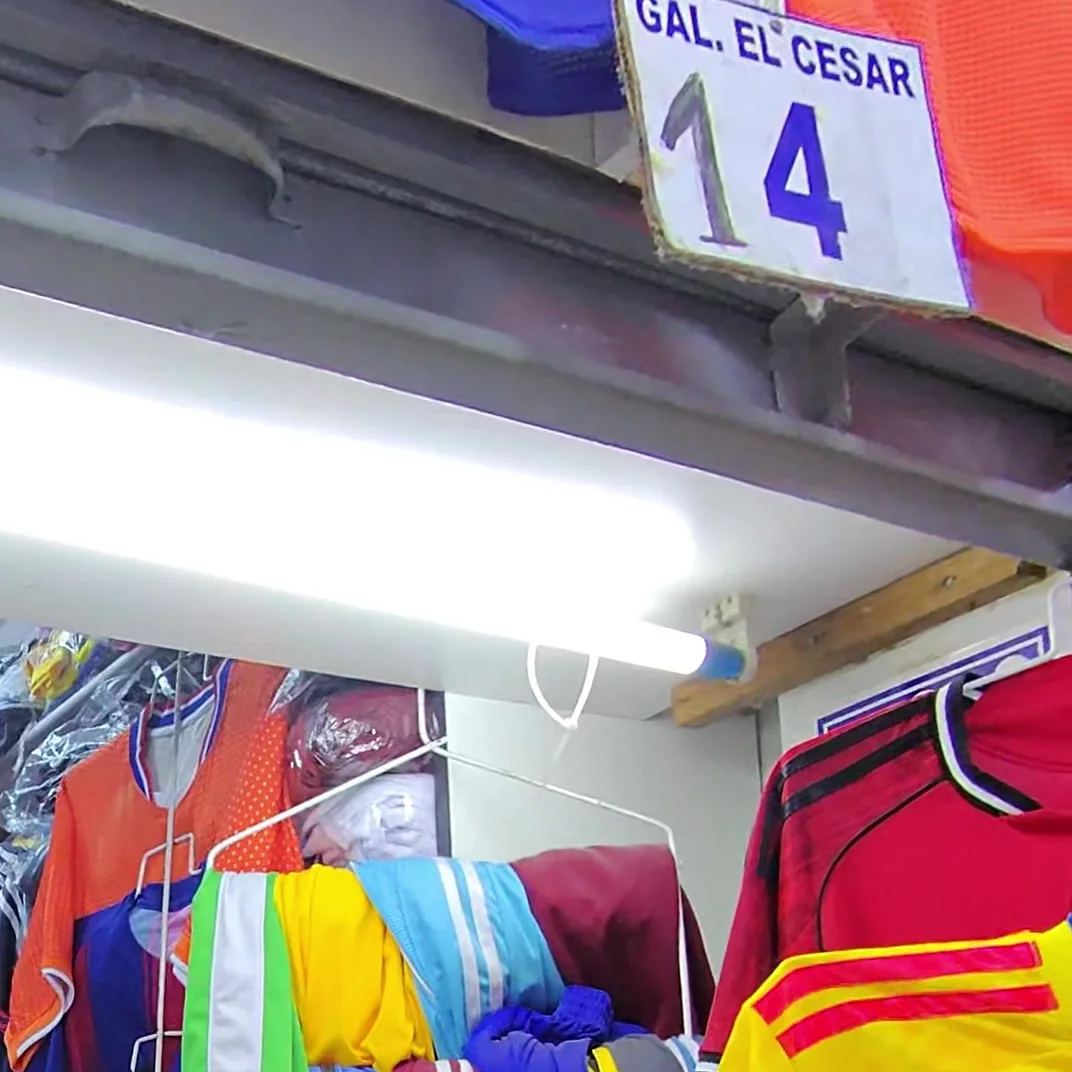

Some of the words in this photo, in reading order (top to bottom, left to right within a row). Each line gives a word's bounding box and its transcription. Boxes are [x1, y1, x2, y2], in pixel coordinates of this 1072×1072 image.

[636, 0, 724, 52] GAL.
[734, 18, 783, 68] EL
[791, 35, 916, 98] CESAR
